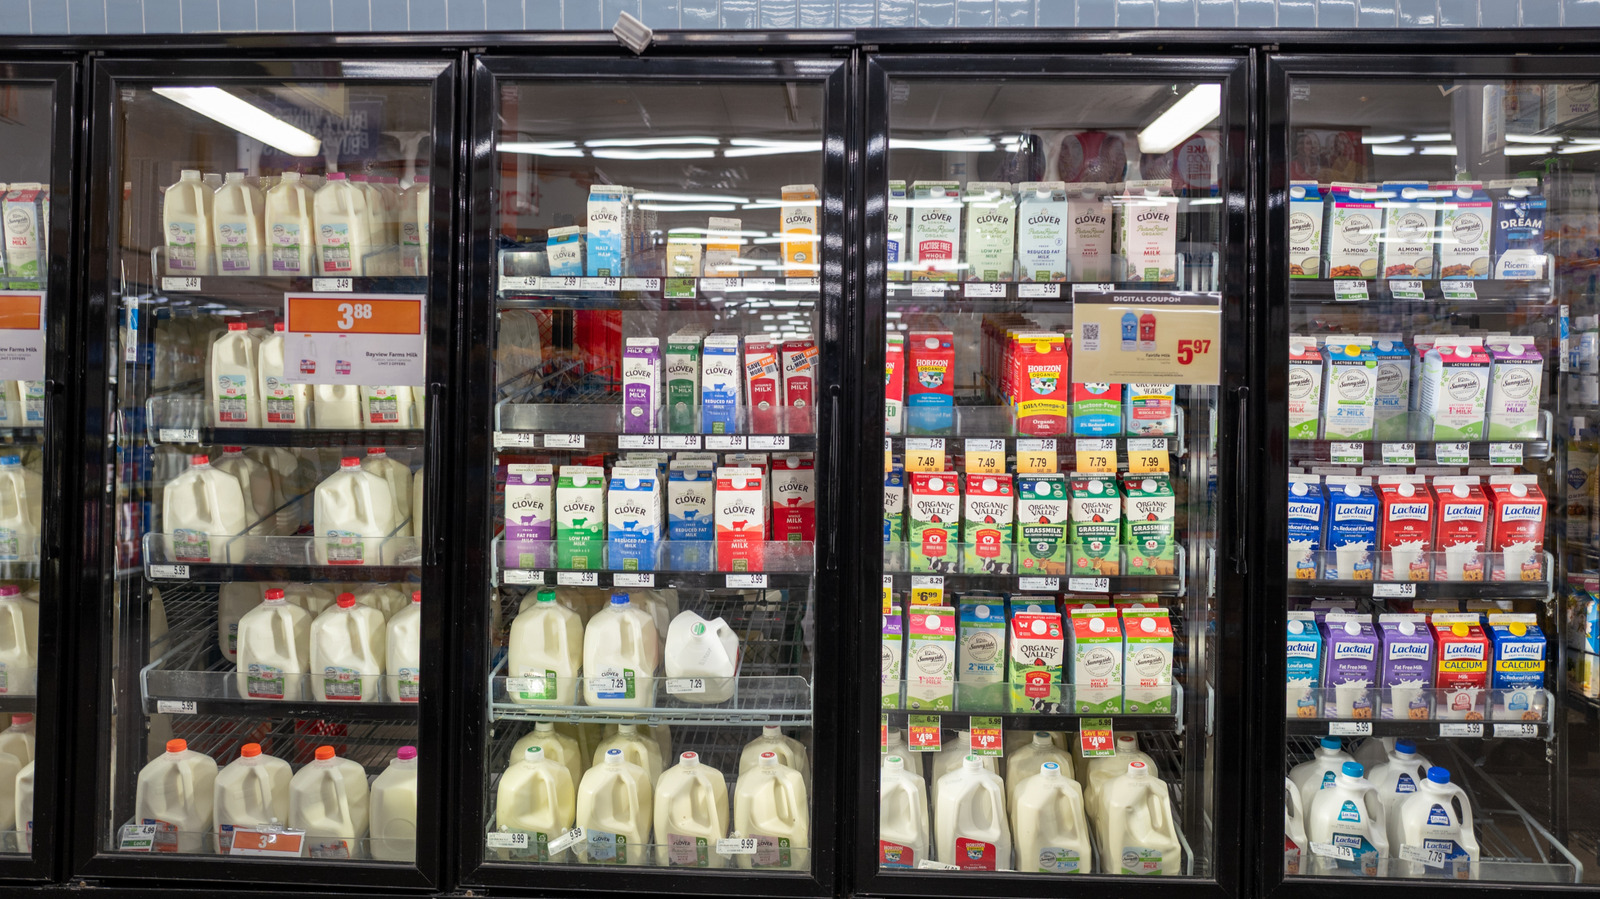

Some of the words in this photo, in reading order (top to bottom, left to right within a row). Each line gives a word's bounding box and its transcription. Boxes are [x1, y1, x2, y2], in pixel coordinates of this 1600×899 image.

[590, 213, 618, 222] CLOVER
[786, 215, 812, 224] CLOVER
[922, 213, 952, 222] CLOVER
[977, 215, 1008, 224] CLOVER
[1028, 216, 1060, 225] CLOVER
[1075, 215, 1106, 225] CLOVER
[1137, 213, 1169, 222] CLOVER
[1454, 222, 1480, 232] Sunnyside
[1500, 218, 1542, 229] DREAM
[921, 242, 939, 251] LACTOSE
[940, 242, 951, 251] FREE
[553, 252, 576, 261] CLOVER
[186, 278, 197, 287] 3.49
[336, 279, 348, 288] 3.49
[524, 278, 536, 286] 4.99
[604, 278, 616, 286] 4.99
[646, 280, 658, 288] 3.99
[990, 284, 1002, 292] 5.99
[1044, 284, 1056, 293] 5.99
[706, 368, 733, 376] CLOVER
[1340, 380, 1367, 388] Sunnyside
[1449, 380, 1478, 389] Sunnyside
[1503, 378, 1530, 387] Sunnyside
[568, 435, 580, 443] 2.49
[643, 436, 654, 444] 2.99
[773, 437, 785, 445] 2.99
[918, 457, 935, 466] 7.49
[978, 458, 995, 467] 7.49
[1030, 458, 1047, 467] 7.79
[1089, 457, 1106, 467] 7.79
[1141, 457, 1158, 466] 7.99
[779, 484, 808, 493] CLOVER
[512, 500, 544, 510] CLOVER
[675, 496, 706, 505] CLOVER
[917, 500, 955, 510] ORGANIC
[1136, 501, 1167, 509] ORGANIC
[563, 504, 595, 513] CLOVER
[723, 506, 755, 515] CLOVER
[971, 501, 1009, 511] ORGANIC
[1028, 504, 1060, 512] ORGANIC
[1081, 502, 1113, 511] ORGANIC
[1338, 506, 1372, 515] Lactaid
[1392, 505, 1426, 514] Lactaid
[1447, 506, 1482, 515] Lactaid
[1505, 506, 1540, 515] Lactaid
[614, 507, 646, 516] CLOVER
[920, 507, 951, 515] VALLEY
[974, 508, 1005, 516] VALLEY
[174, 565, 185, 574] 5.99
[582, 573, 593, 581] 3.99
[638, 574, 650, 582] 3.99
[751, 575, 762, 583] 3.99
[1094, 579, 1107, 588] 8.49
[1400, 584, 1412, 594] 5.99
[968, 642, 995, 650] Sunnyside
[1020, 644, 1059, 654] ORGANIC
[1337, 644, 1372, 654] Lactaid
[1392, 645, 1426, 654] Lactaid
[1447, 645, 1482, 654] Lactaid
[1504, 645, 1539, 654] Lactaid
[1085, 656, 1111, 666] Sunnyside
[1136, 656, 1162, 666] Sunnyside
[612, 679, 624, 688] 7.29
[690, 679, 702, 688] 7.29
[182, 701, 193, 710] 5.99
[1356, 723, 1368, 732] 5.99
[1467, 723, 1480, 733] 5.99
[1521, 724, 1534, 734] 5.99
[512, 834, 524, 843] 9.99
[1335, 836, 1360, 846] Lactaid
[741, 839, 754, 848] 9.99
[1427, 842, 1451, 852] Lactaid
[1336, 847, 1350, 856] 7.79
[1428, 851, 1442, 862] 7.79
